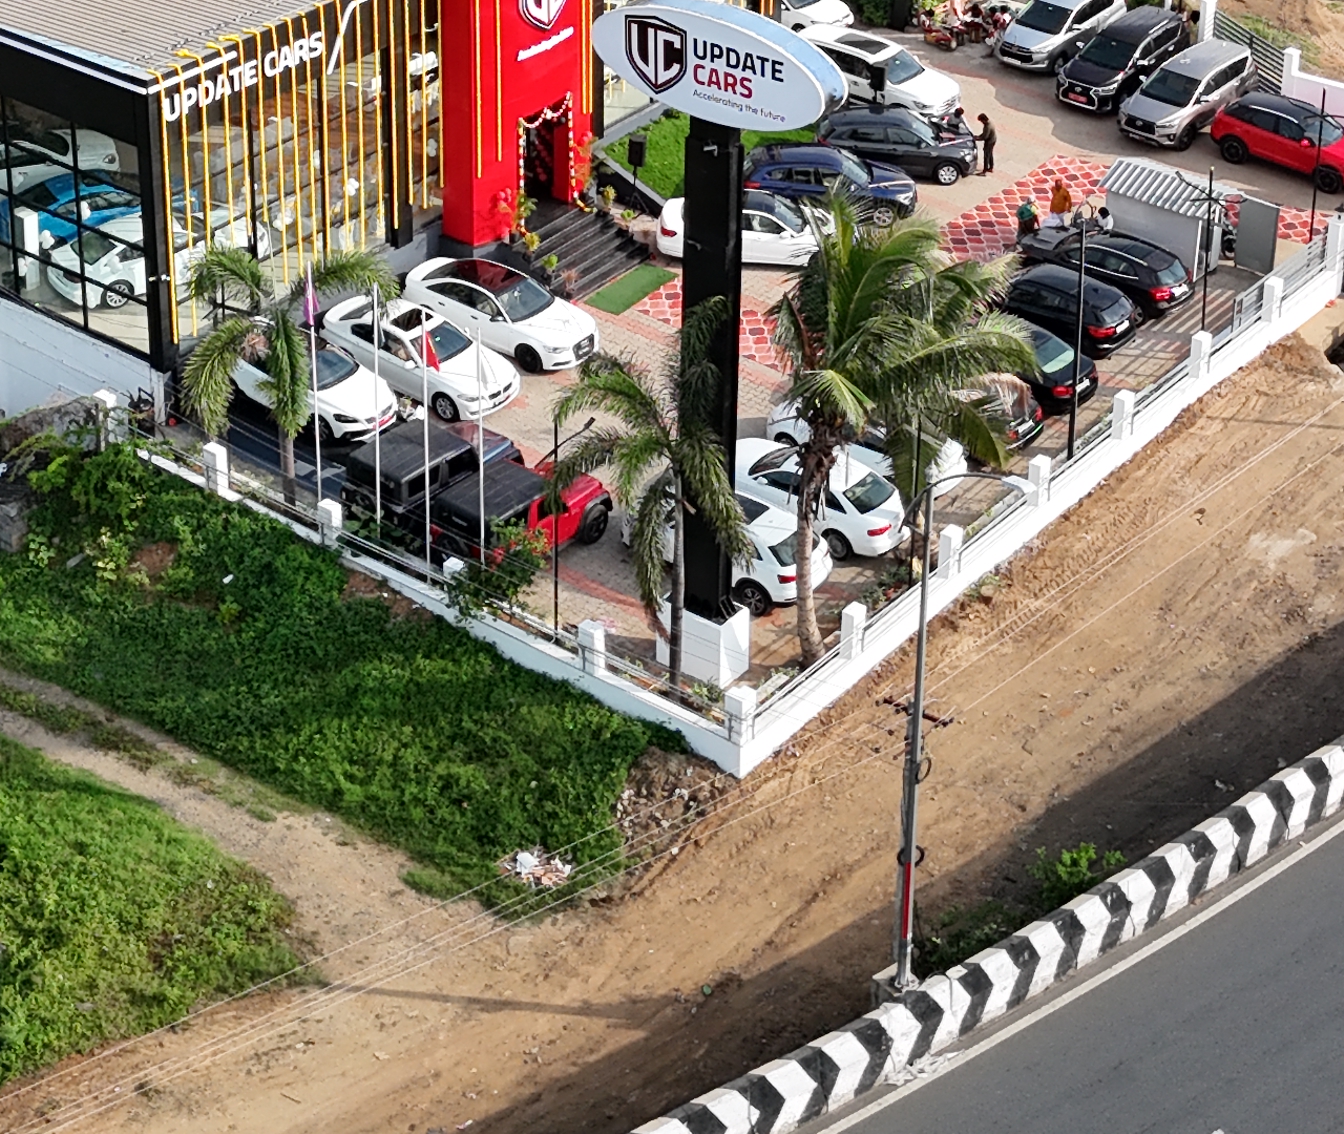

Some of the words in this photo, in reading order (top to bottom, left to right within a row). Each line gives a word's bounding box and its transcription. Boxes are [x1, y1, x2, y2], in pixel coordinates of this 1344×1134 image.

[163, 60, 259, 122] UPDATE
[264, 31, 324, 78] CARS
[631, 22, 684, 86] UC
[693, 38, 785, 83] UPDATE
[693, 63, 754, 100] CARS
[692, 89, 744, 112] Accelerating
[745, 103, 759, 115] the
[760, 107, 787, 123] future
